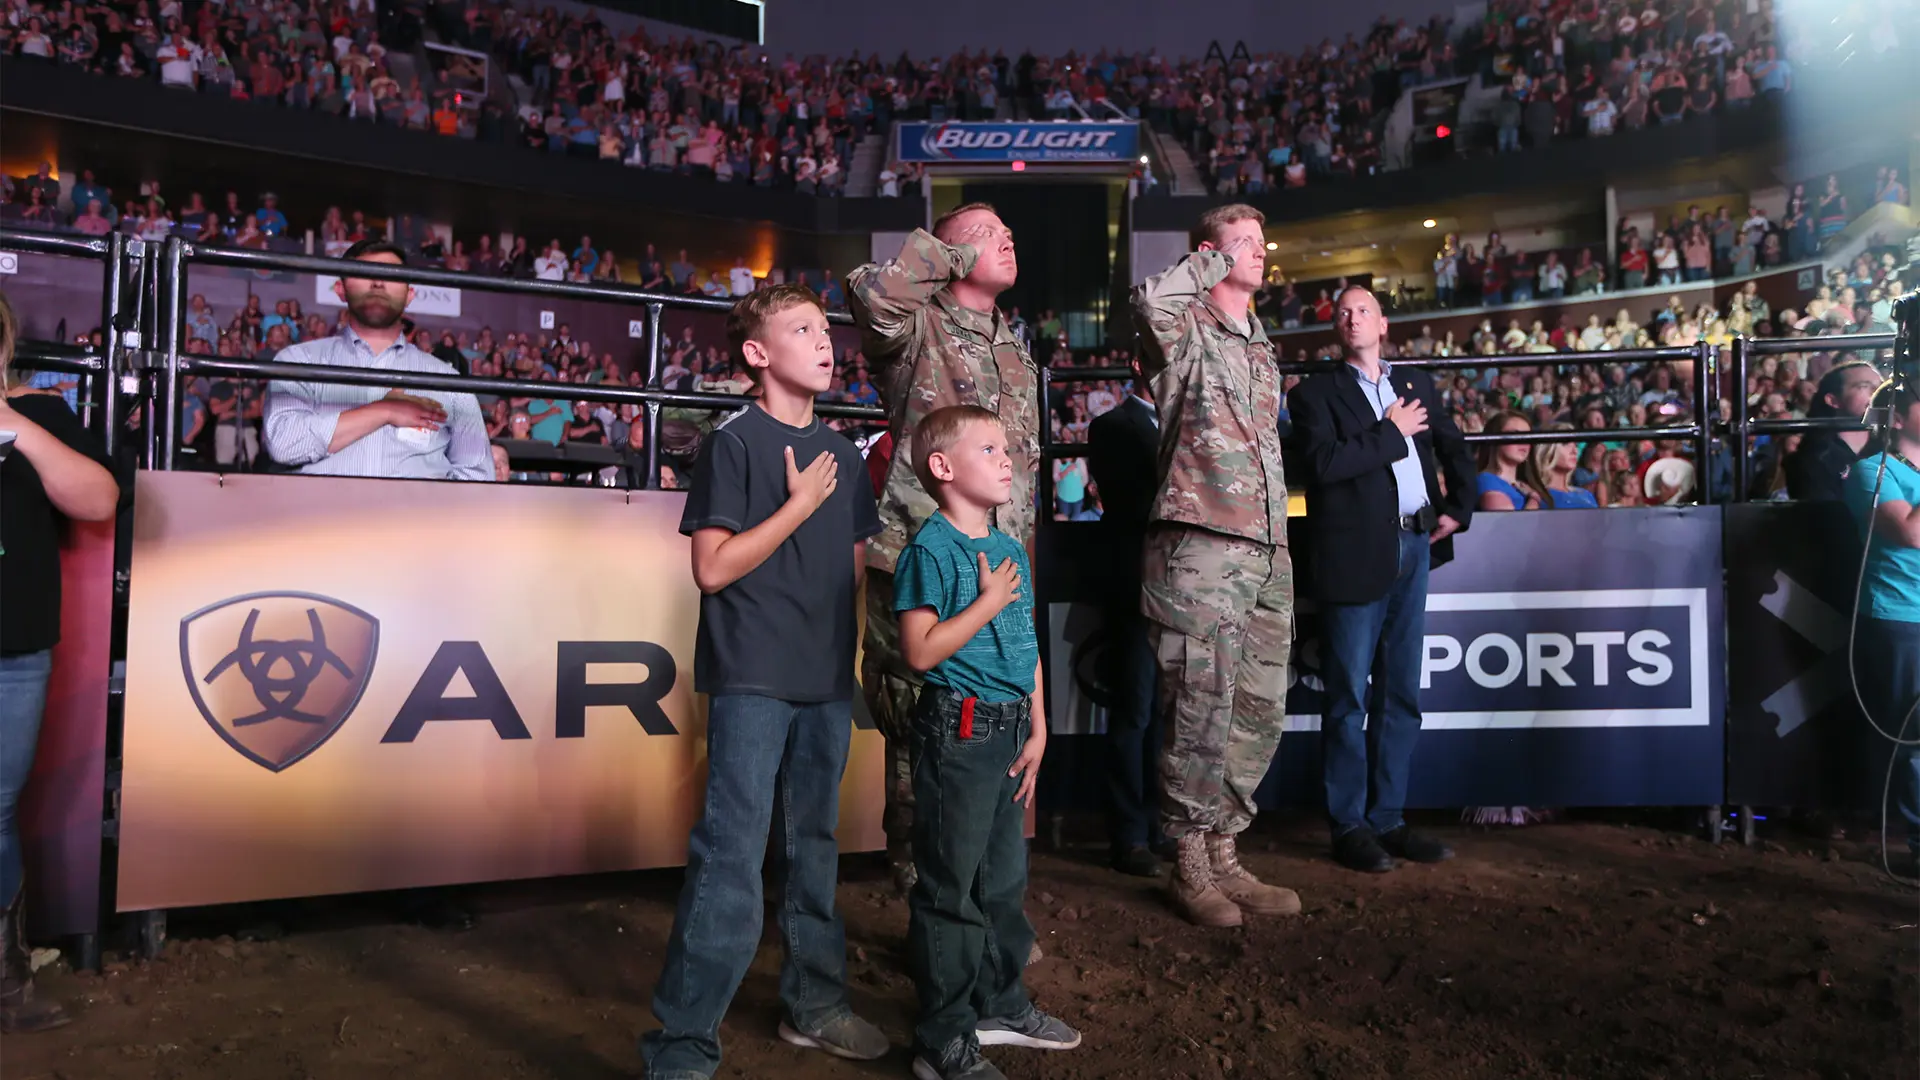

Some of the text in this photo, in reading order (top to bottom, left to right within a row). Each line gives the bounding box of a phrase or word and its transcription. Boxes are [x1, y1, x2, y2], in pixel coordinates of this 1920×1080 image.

[936, 128, 1117, 148] BUD LIGHT
[415, 287, 453, 303] ONS
[1418, 629, 1674, 690] PORTS
